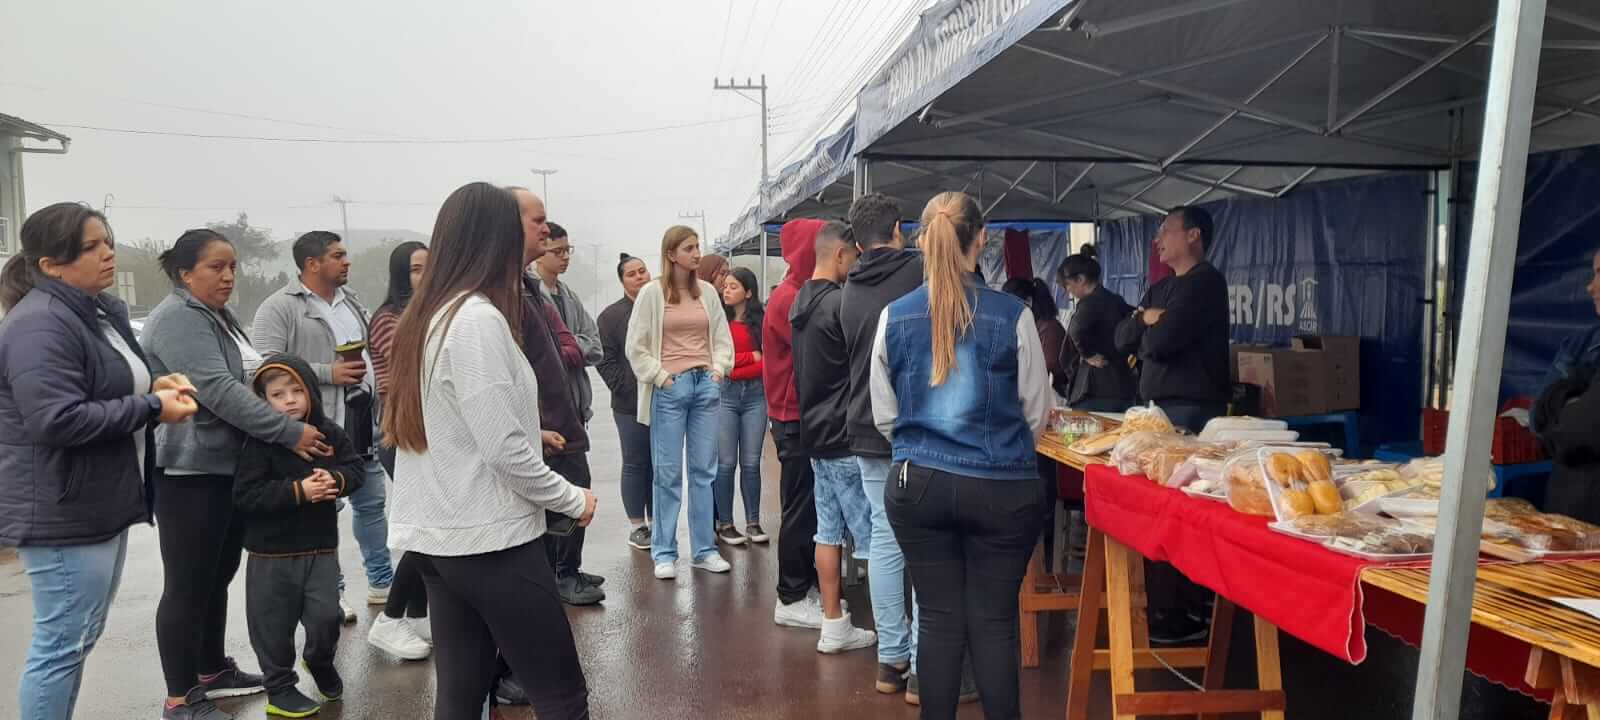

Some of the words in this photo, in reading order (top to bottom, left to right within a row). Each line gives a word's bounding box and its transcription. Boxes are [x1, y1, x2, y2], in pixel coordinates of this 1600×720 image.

[917, 39, 931, 88] DA
[932, 0, 1029, 78] AGRICULTU
[1228, 280, 1297, 329] ER/RS
